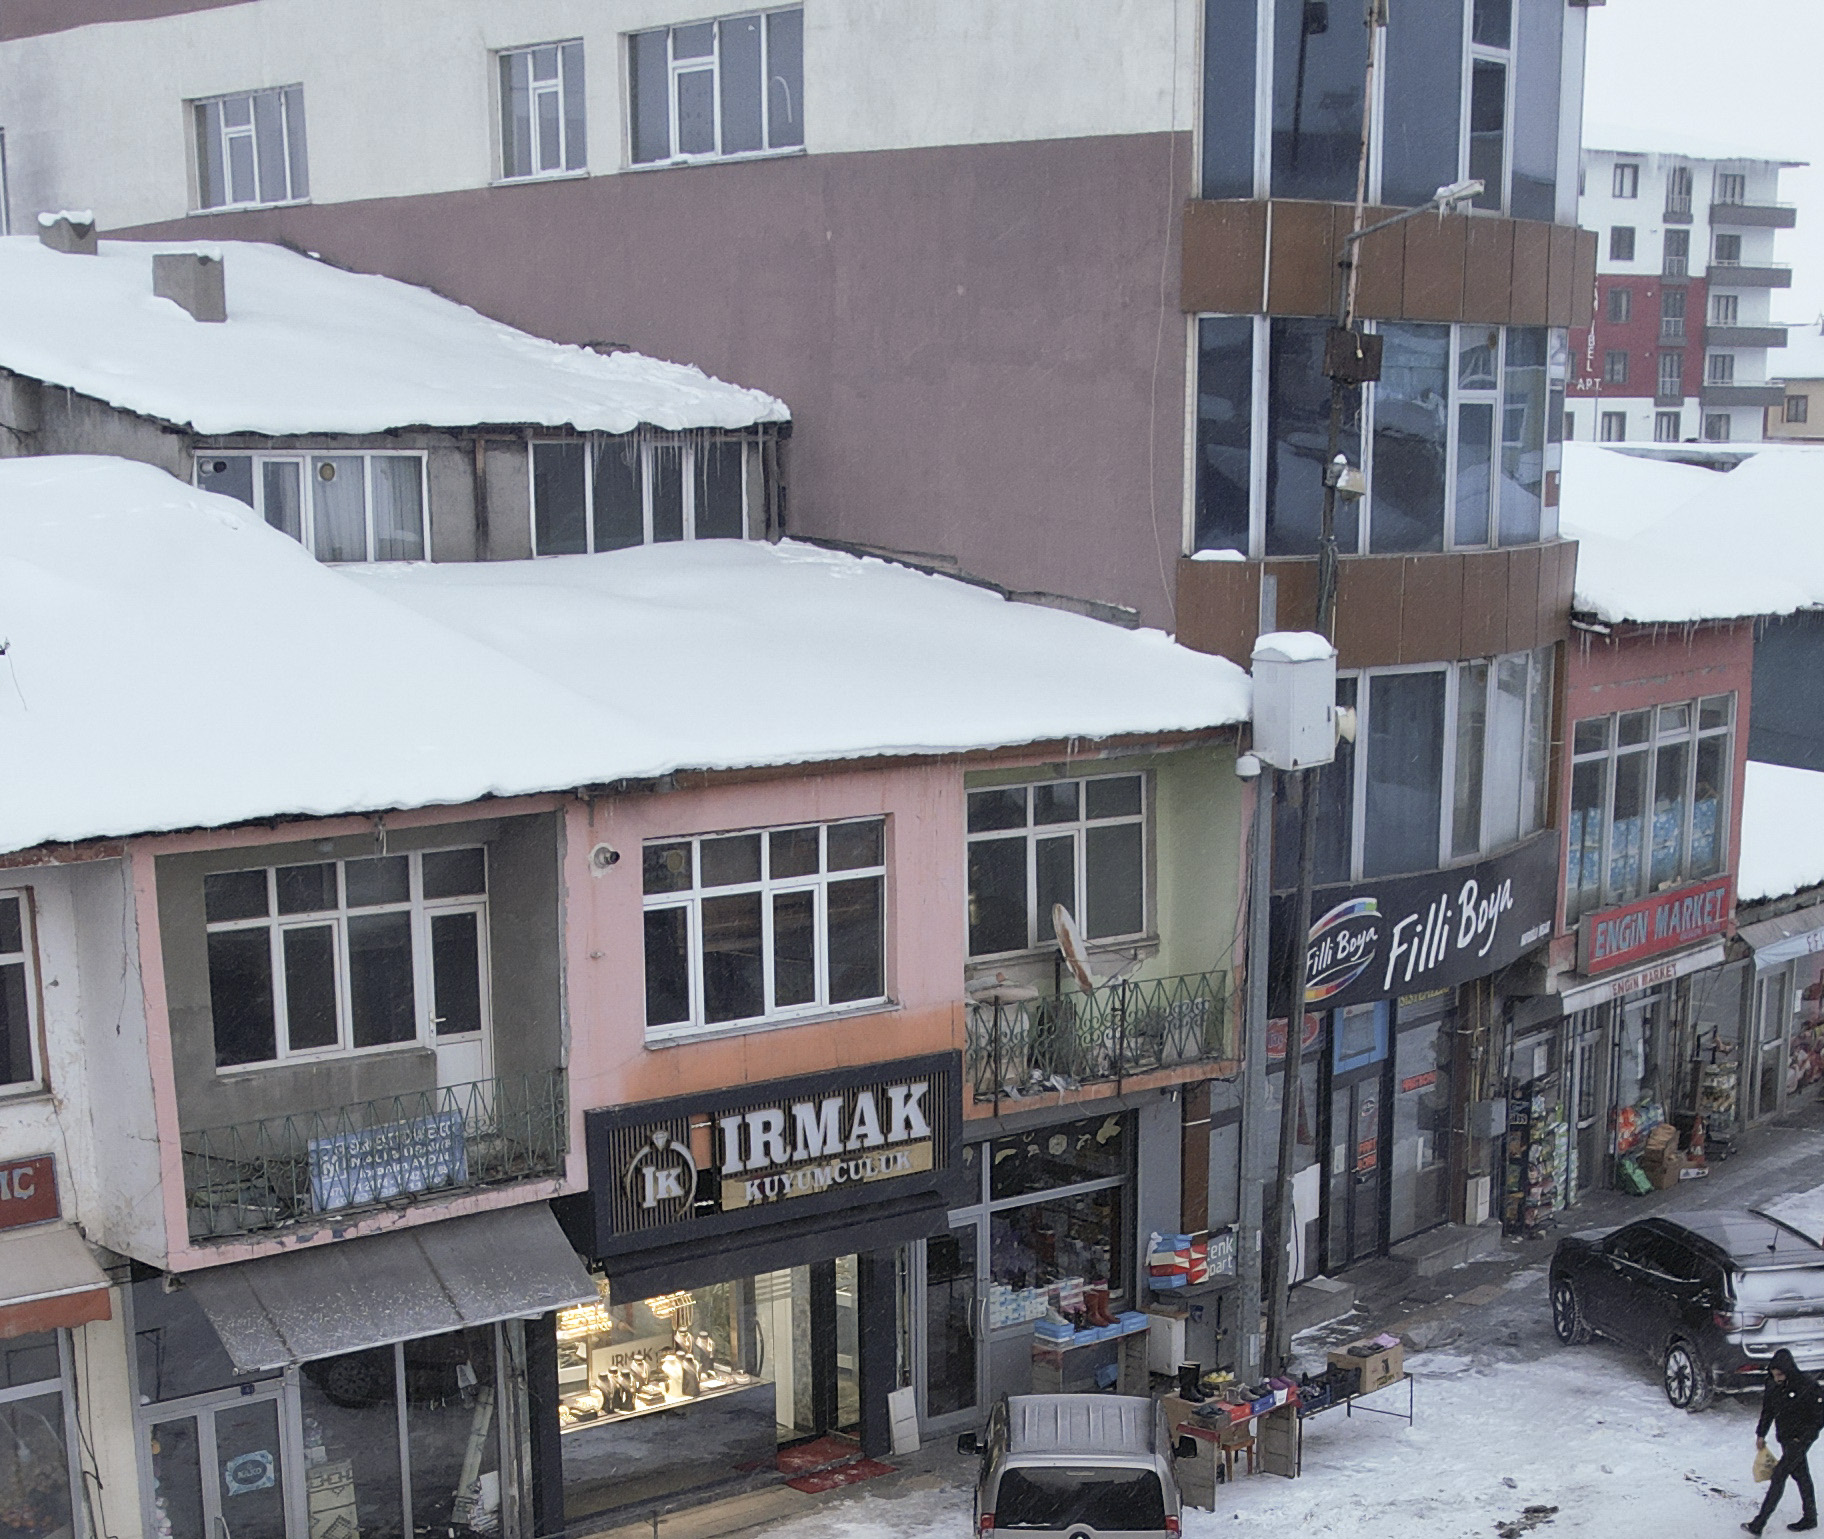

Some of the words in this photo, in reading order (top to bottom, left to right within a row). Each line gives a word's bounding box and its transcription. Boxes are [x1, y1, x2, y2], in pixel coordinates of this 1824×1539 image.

[1336, 926, 1379, 962] Boya
[1383, 892, 1453, 991] Filli
[1457, 878, 1514, 957] Boya
[1594, 908, 1650, 959] ENGİN
[1654, 887, 1726, 941] MARKET
[719, 1081, 933, 1176] IRMAK
[745, 1149, 912, 1203] KUYUMCULUK
[1207, 1236, 1234, 1260] enk
